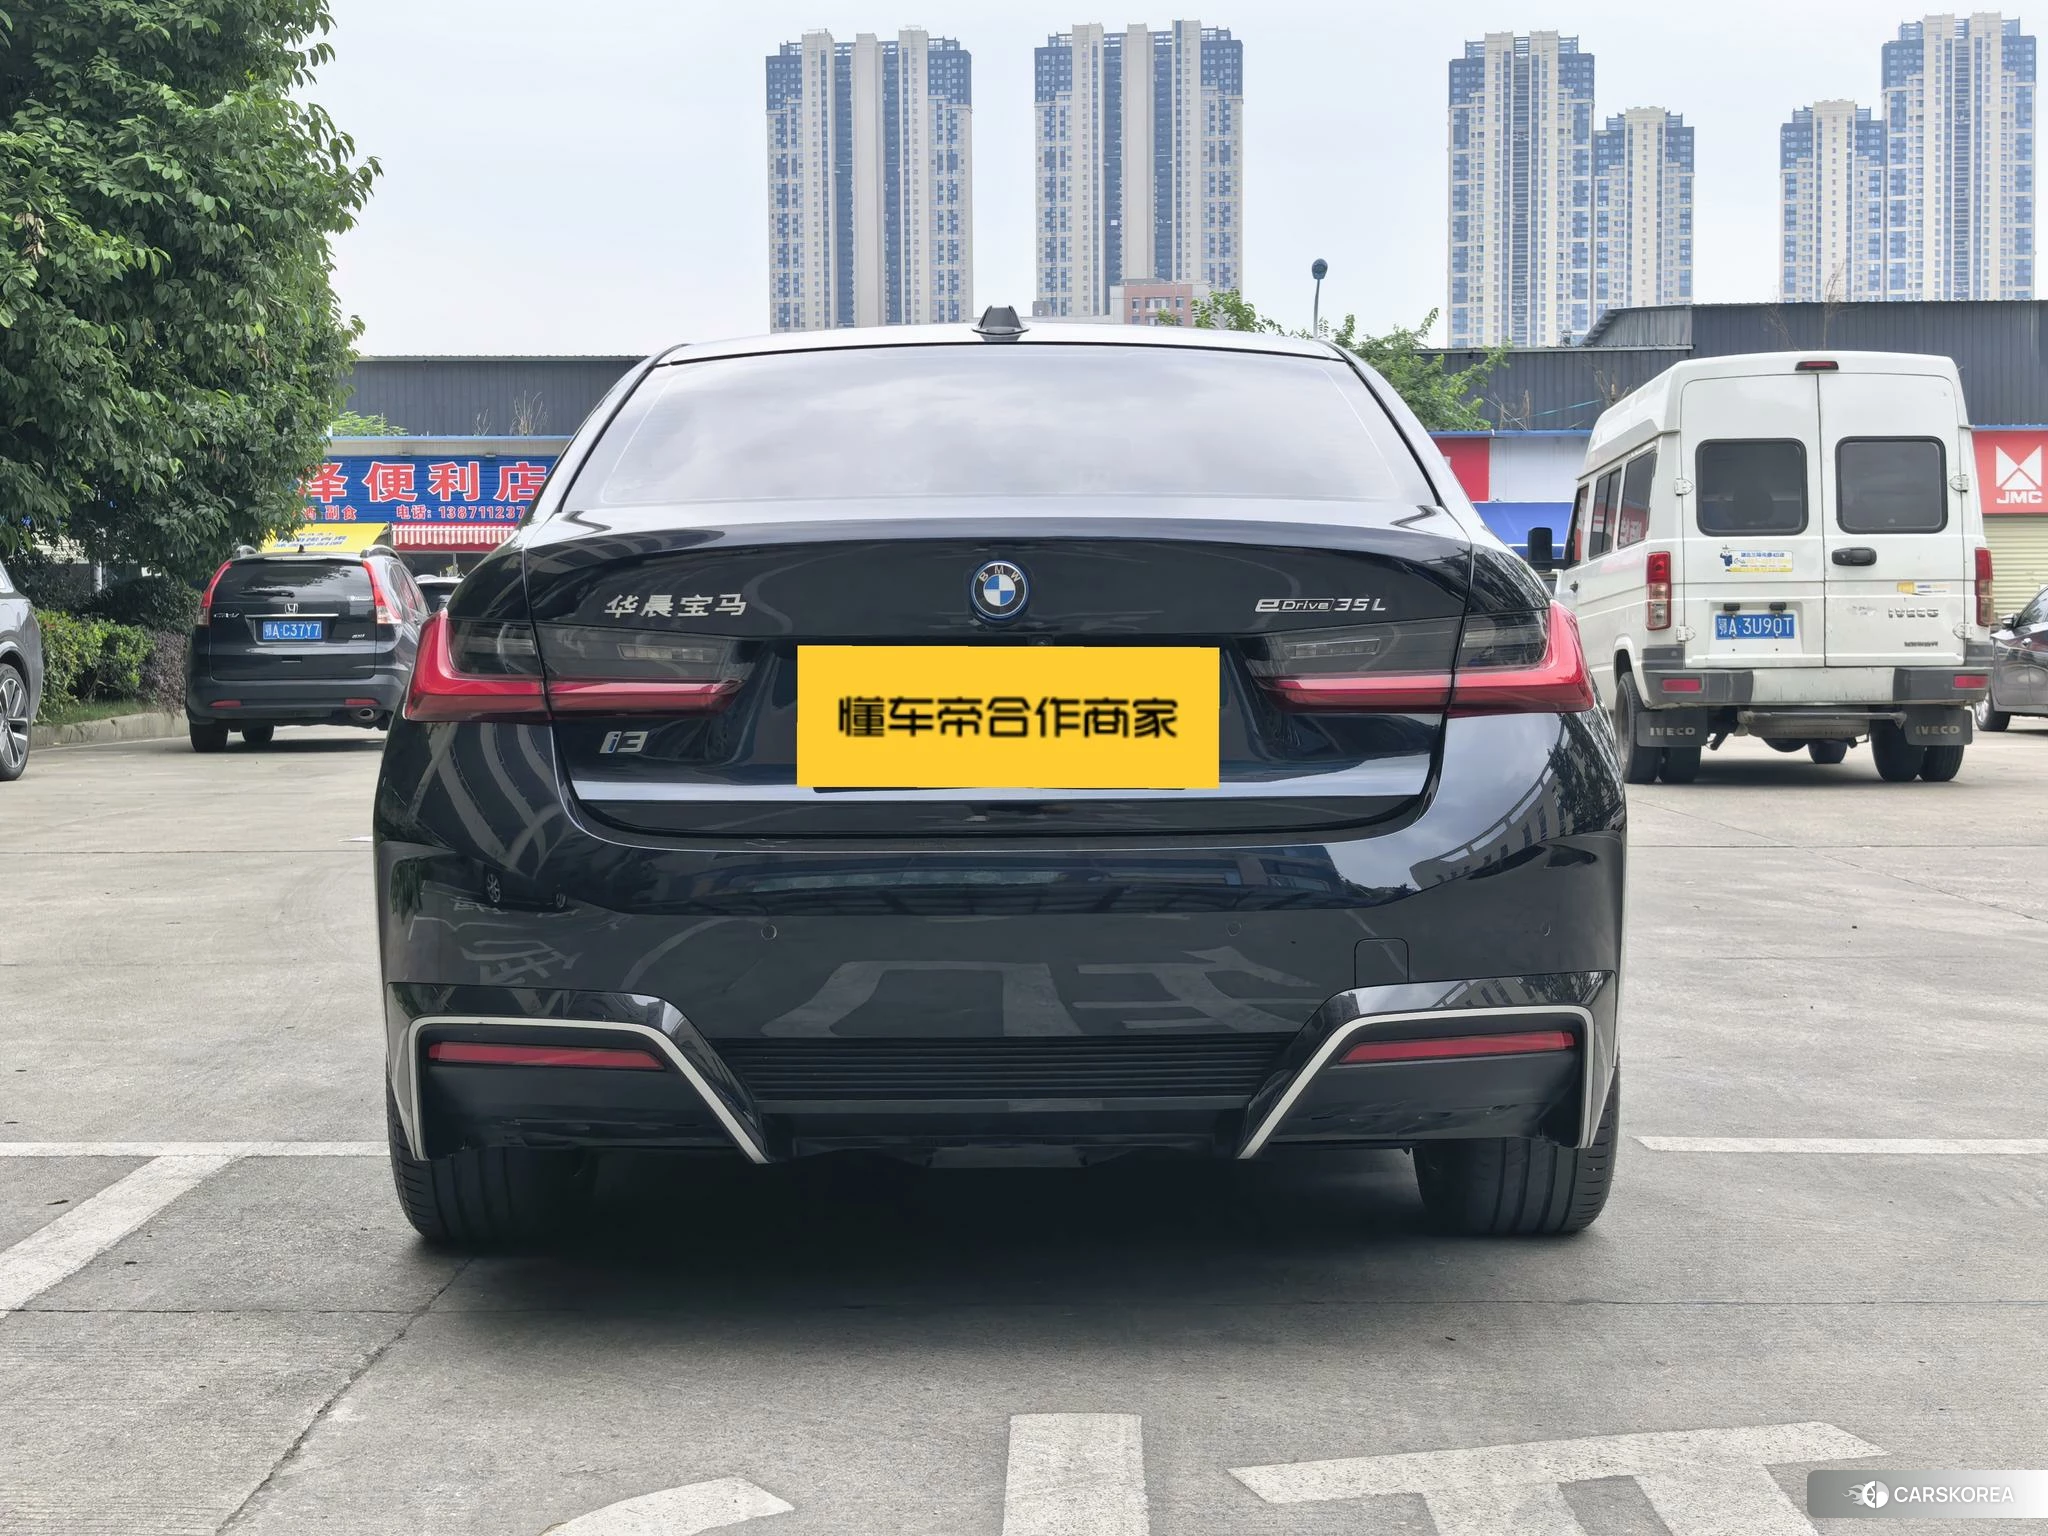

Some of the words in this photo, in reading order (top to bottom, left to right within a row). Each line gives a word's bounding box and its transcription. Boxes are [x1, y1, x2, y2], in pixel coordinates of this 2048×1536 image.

[1996, 490, 2043, 504] JMC
[325, 505, 357, 520] 副食
[979, 565, 1021, 582] BMW
[604, 594, 747, 618] 华晨宝马
[1649, 727, 1696, 737] IVECO
[1915, 725, 1961, 736] IVECO
[600, 731, 649, 753] i3
